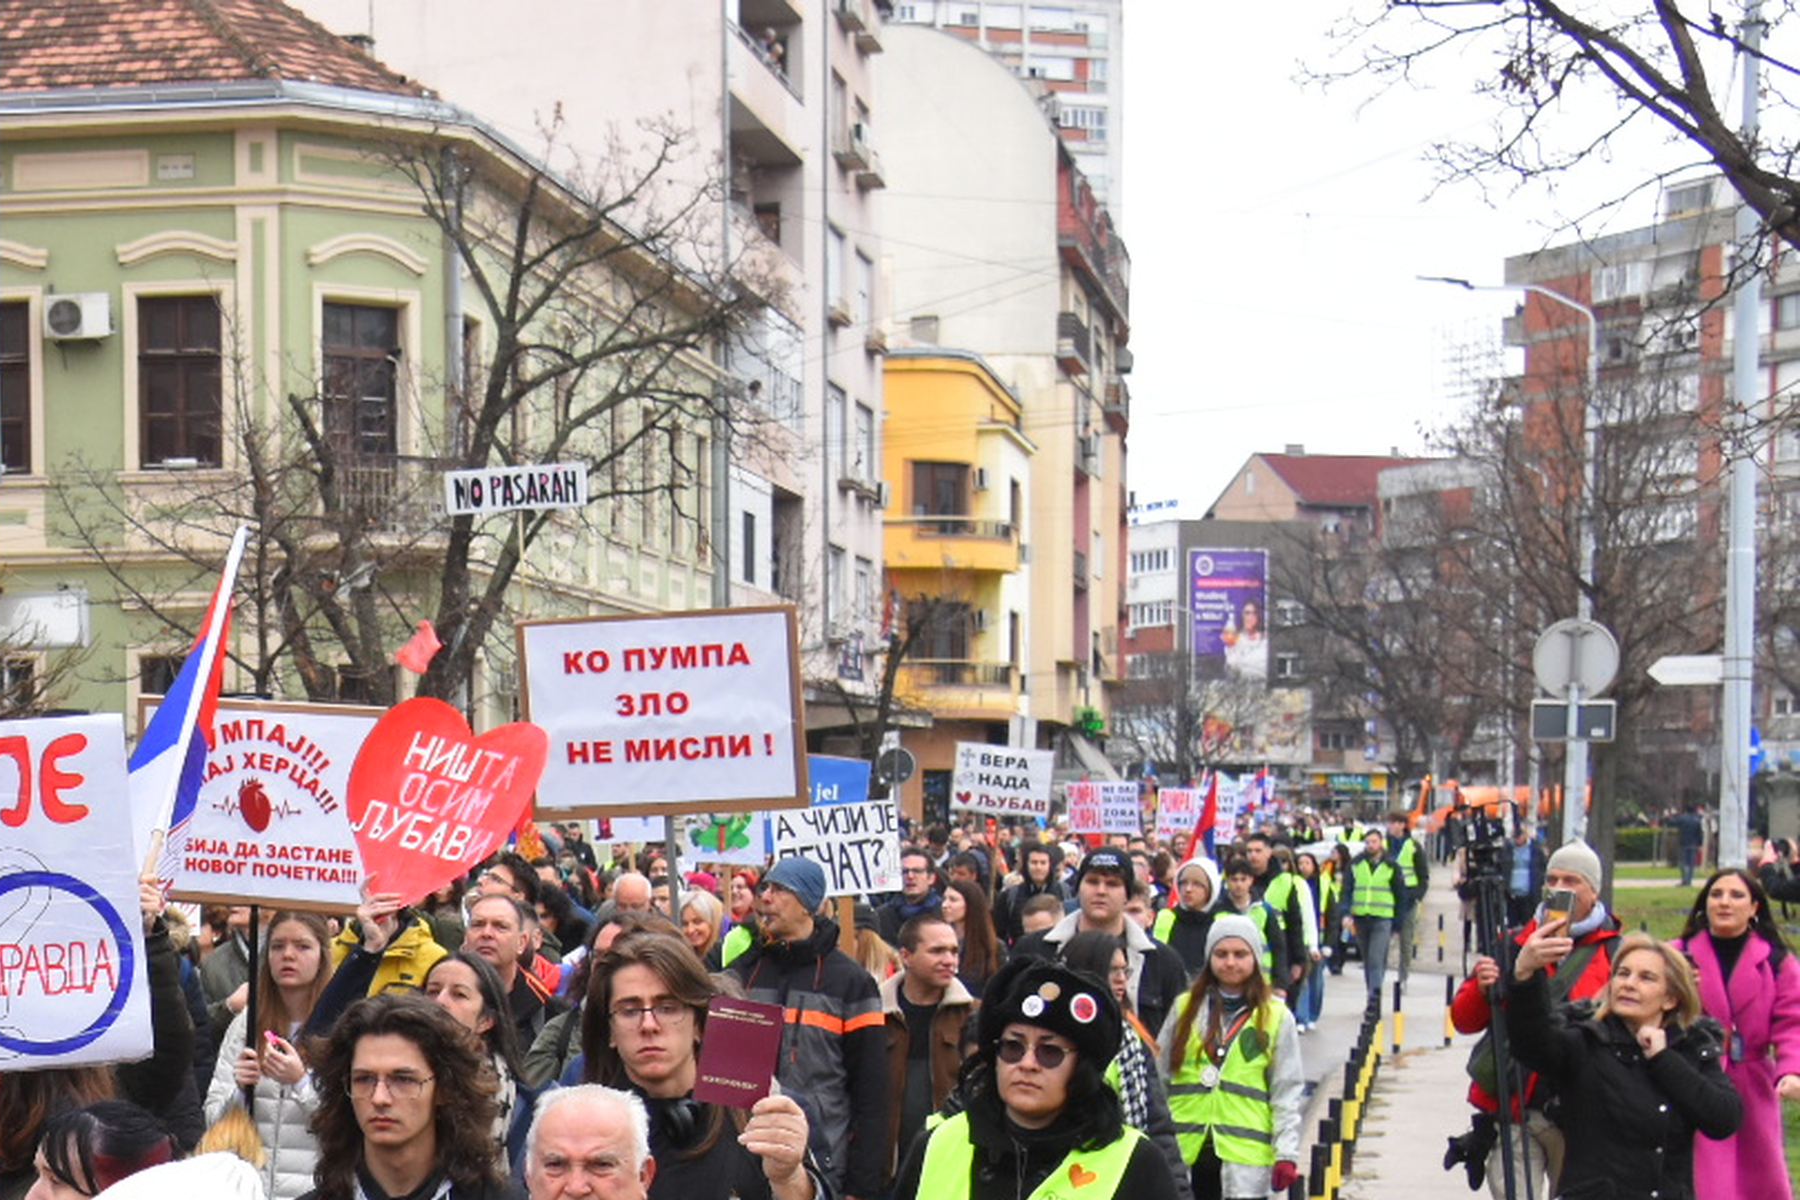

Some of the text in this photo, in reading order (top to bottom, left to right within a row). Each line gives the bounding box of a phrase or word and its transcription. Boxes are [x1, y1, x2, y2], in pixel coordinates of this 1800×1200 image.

[563, 642, 751, 675] КО ПУМПА
[616, 691, 689, 717] ЗЛО
[403, 730, 522, 791] НИШТА
[566, 741, 613, 765] НЕ
[625, 735, 752, 763] МИСЛИ
[980, 753, 1028, 769] ВЕРА
[205, 752, 339, 815] АЈ ХЕРЦА!!!
[978, 773, 1030, 790] НАДА
[399, 773, 493, 825] ОСИМ
[976, 794, 1046, 812] ЉУБАВ
[351, 799, 493, 865] ЉУБАВИ
[777, 815, 796, 841] А
[871, 804, 898, 834] ЈЕ
[234, 841, 260, 859] ДА
[265, 843, 353, 864] ЗАСТАНЕ
[185, 857, 357, 884] НОВОГ ПОЧЕТКА!!!
